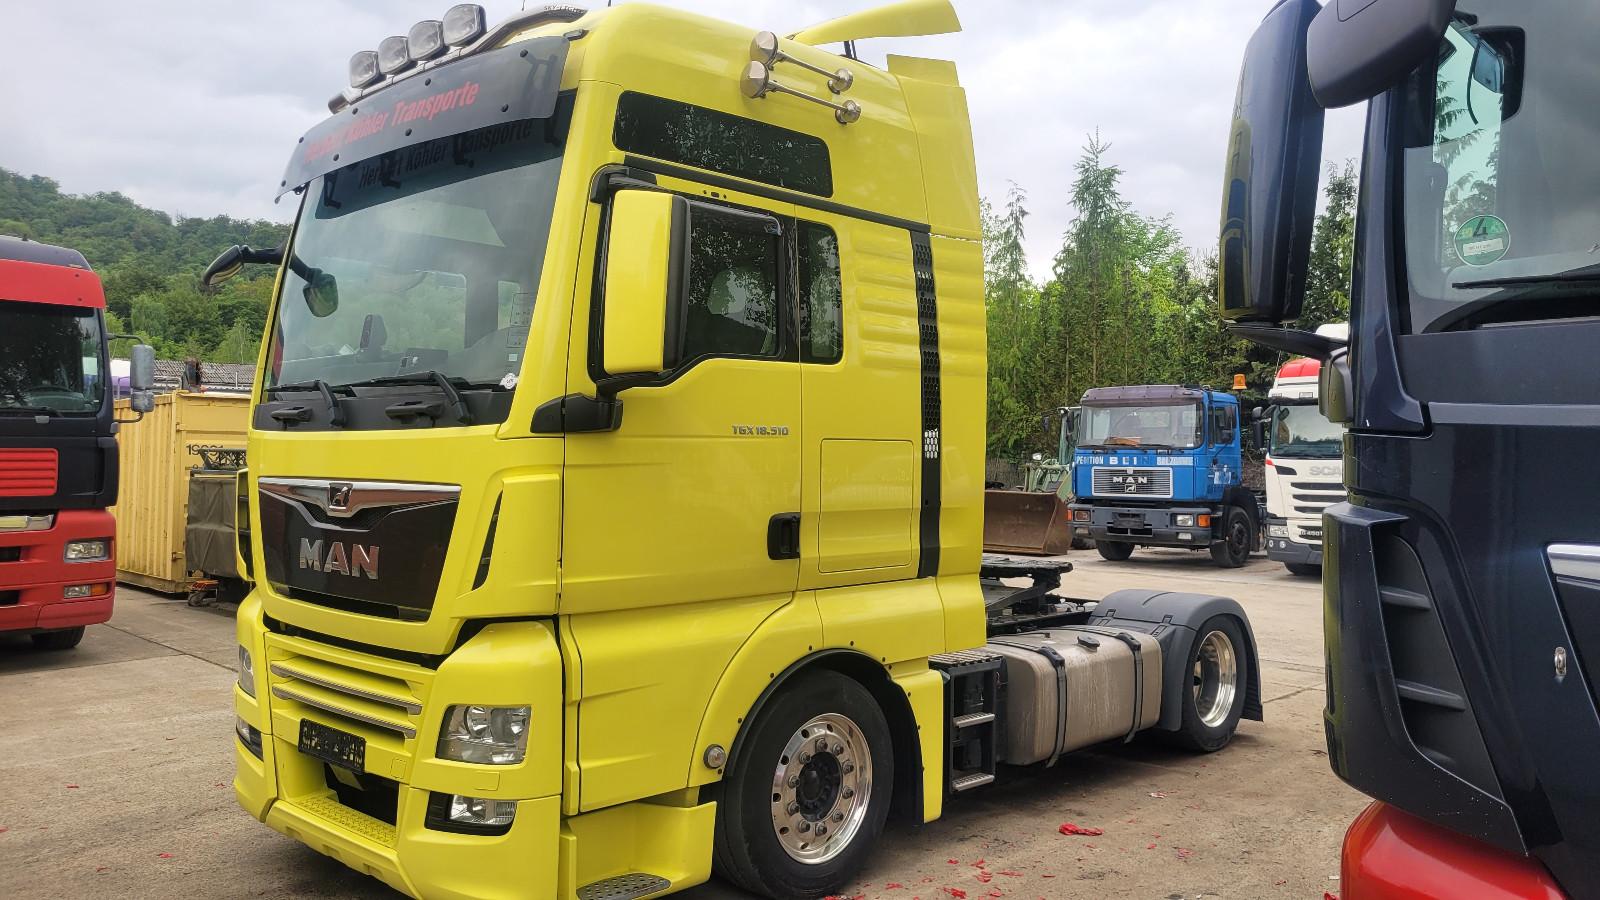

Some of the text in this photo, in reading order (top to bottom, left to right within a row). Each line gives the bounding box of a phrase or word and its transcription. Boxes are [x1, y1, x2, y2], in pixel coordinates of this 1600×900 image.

[392, 81, 480, 126] Transporte
[452, 119, 533, 154] ansporte
[732, 425, 789, 436] TGX 18.510
[1112, 476, 1148, 484] MAN
[300, 537, 380, 580] MAN
